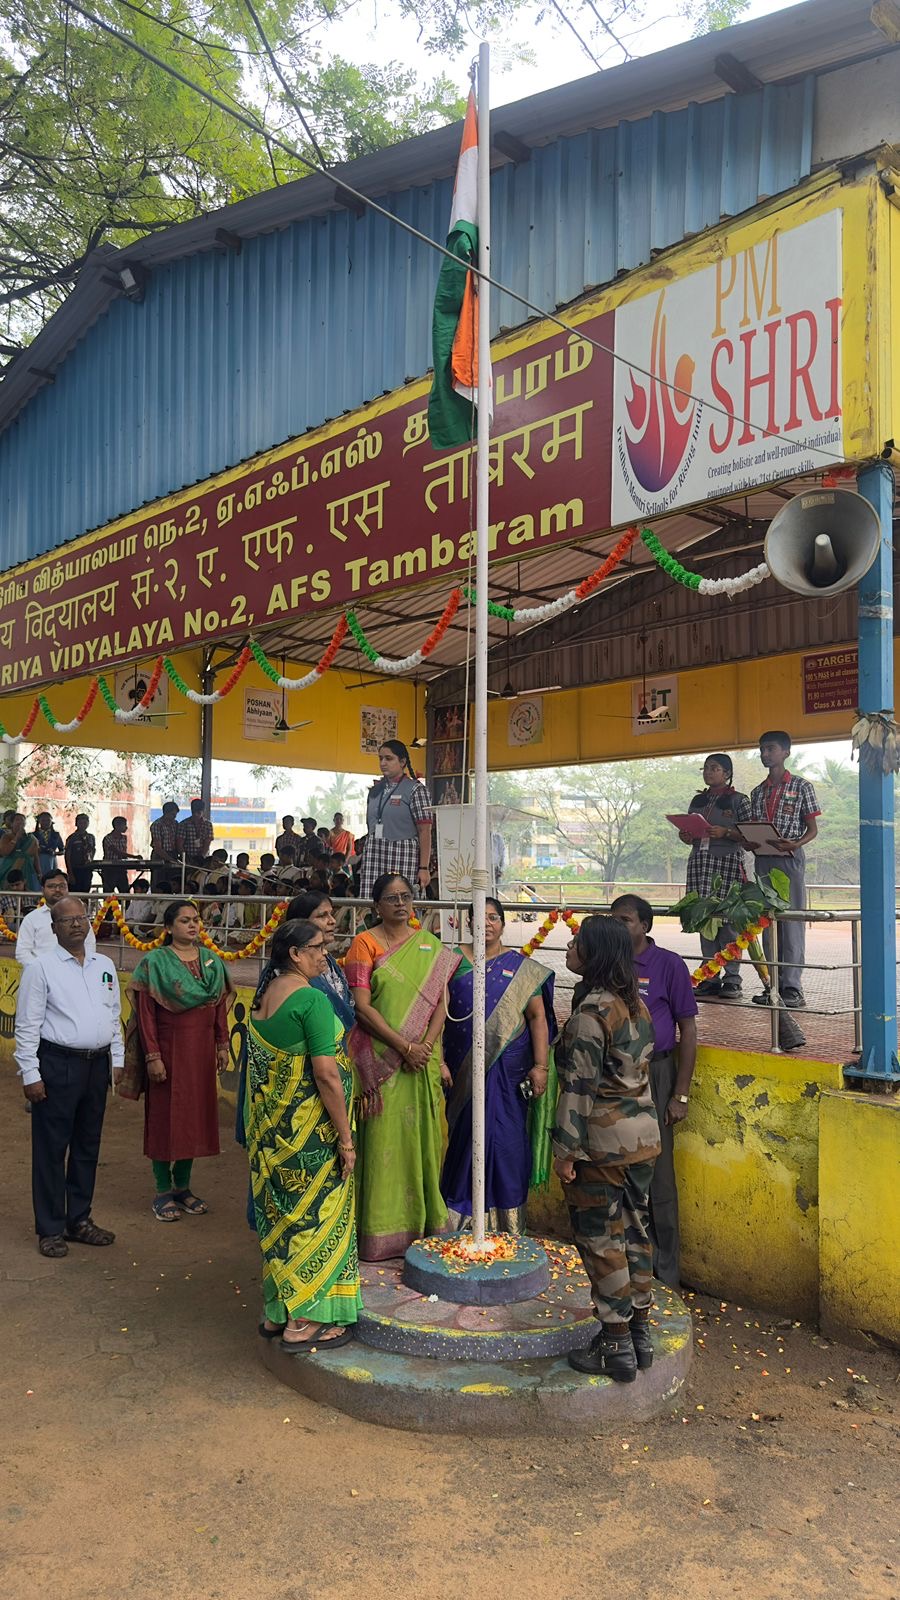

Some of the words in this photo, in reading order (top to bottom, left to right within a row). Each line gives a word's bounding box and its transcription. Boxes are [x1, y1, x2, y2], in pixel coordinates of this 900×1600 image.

[711, 234, 782, 339] PM
[709, 297, 842, 455] SHRI
[628, 481, 645, 513] Mantri
[669, 484, 679, 504] for
[677, 444, 696, 487] Rising
[692, 398, 704, 440] India
[707, 464, 732, 478] Creating
[732, 454, 754, 472] holistic
[754, 450, 766, 464] and
[766, 438, 807, 460] well-rounded
[797, 460, 815, 473] skills
[326, 480, 391, 543] एस
[50, 617, 174, 673] VIDYALAYA
[266, 569, 331, 616] AFS
[345, 498, 584, 592] Tambaram
[247, 698, 271, 708] POSHAN
[247, 706, 272, 716] Abhiyaan
[813, 700, 829, 709] Class
